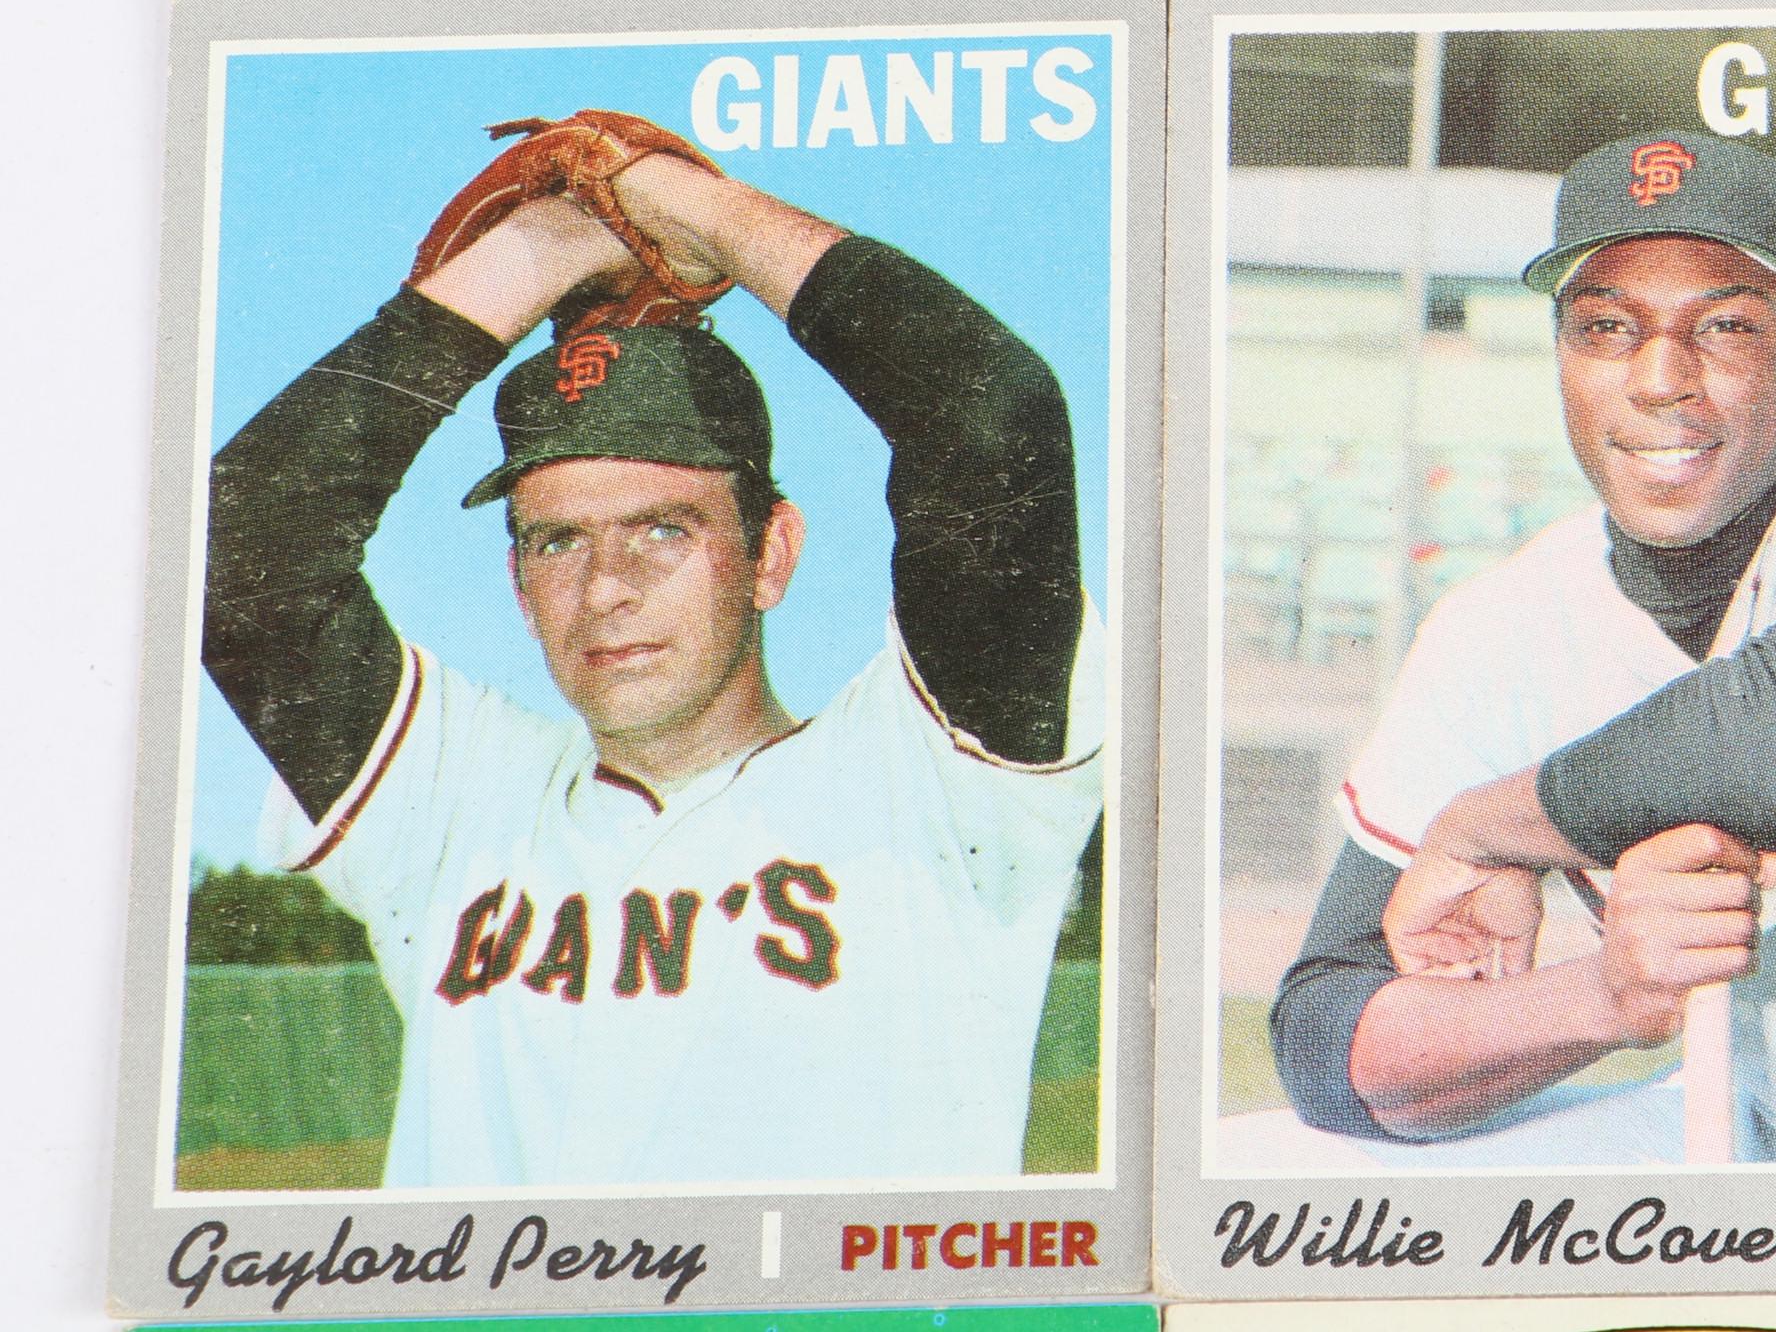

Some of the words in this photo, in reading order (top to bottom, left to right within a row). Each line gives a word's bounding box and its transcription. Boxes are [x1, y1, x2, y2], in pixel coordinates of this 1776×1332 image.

[689, 47, 1098, 151] GIANTS
[166, 1213, 470, 1311] Gaylord
[491, 1213, 709, 1306] Perry
[840, 1220, 1101, 1272] PITCHER
[1213, 1197, 1446, 1268] Willie
